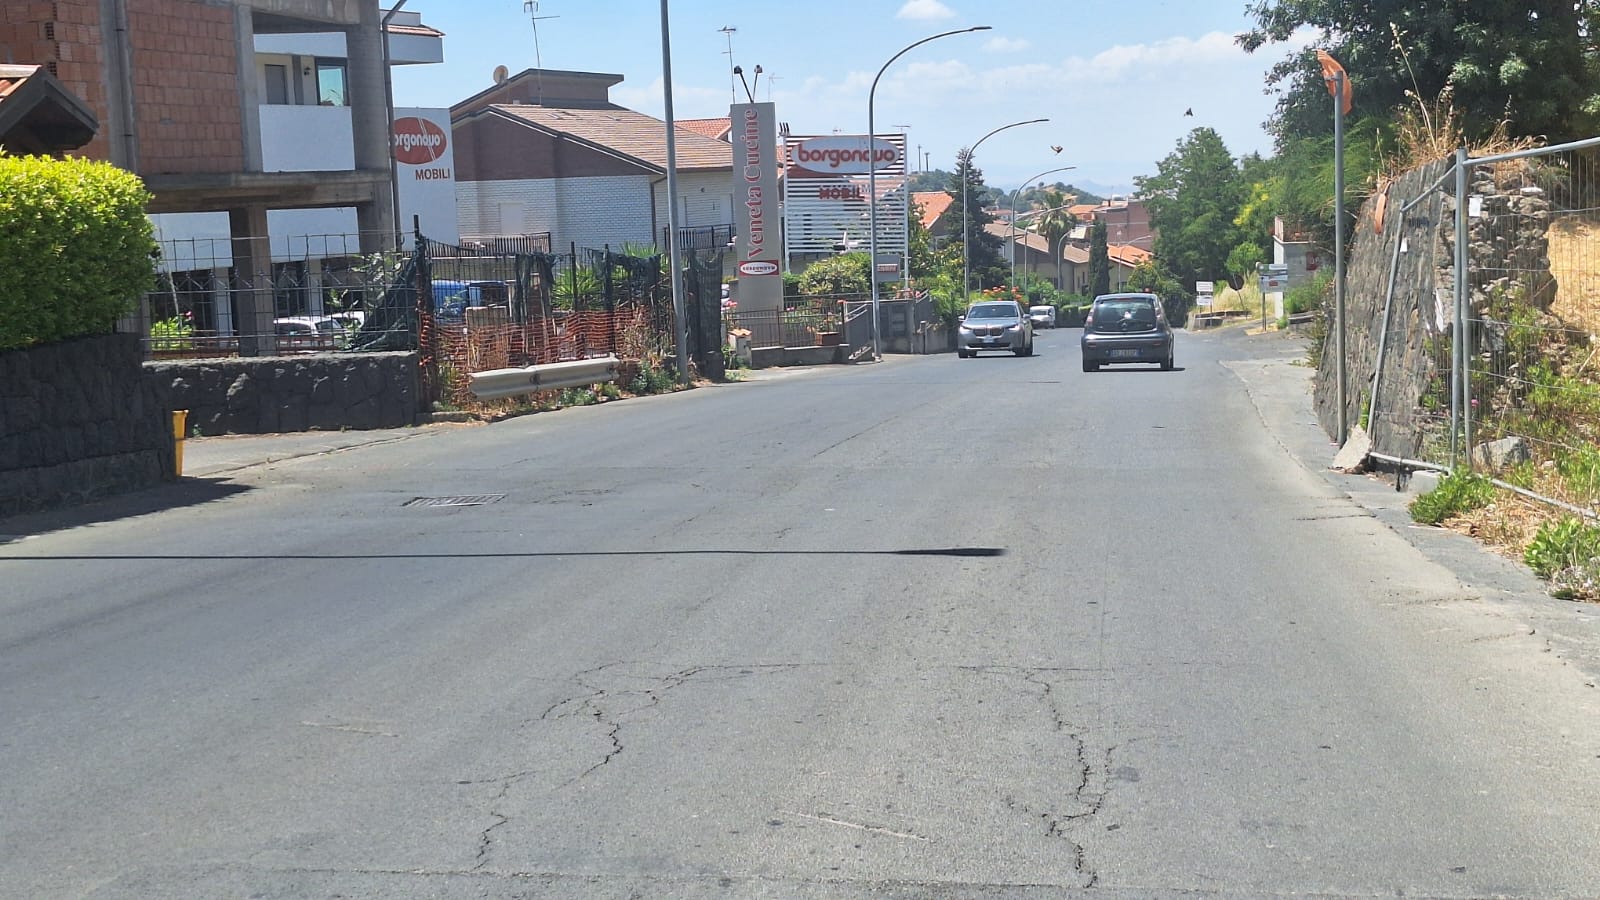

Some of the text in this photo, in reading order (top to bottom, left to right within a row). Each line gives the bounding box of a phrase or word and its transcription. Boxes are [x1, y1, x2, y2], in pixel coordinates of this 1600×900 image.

[415, 168, 450, 180] MOBILI
[741, 108, 762, 182] Cucine
[746, 186, 764, 259] Veneta
